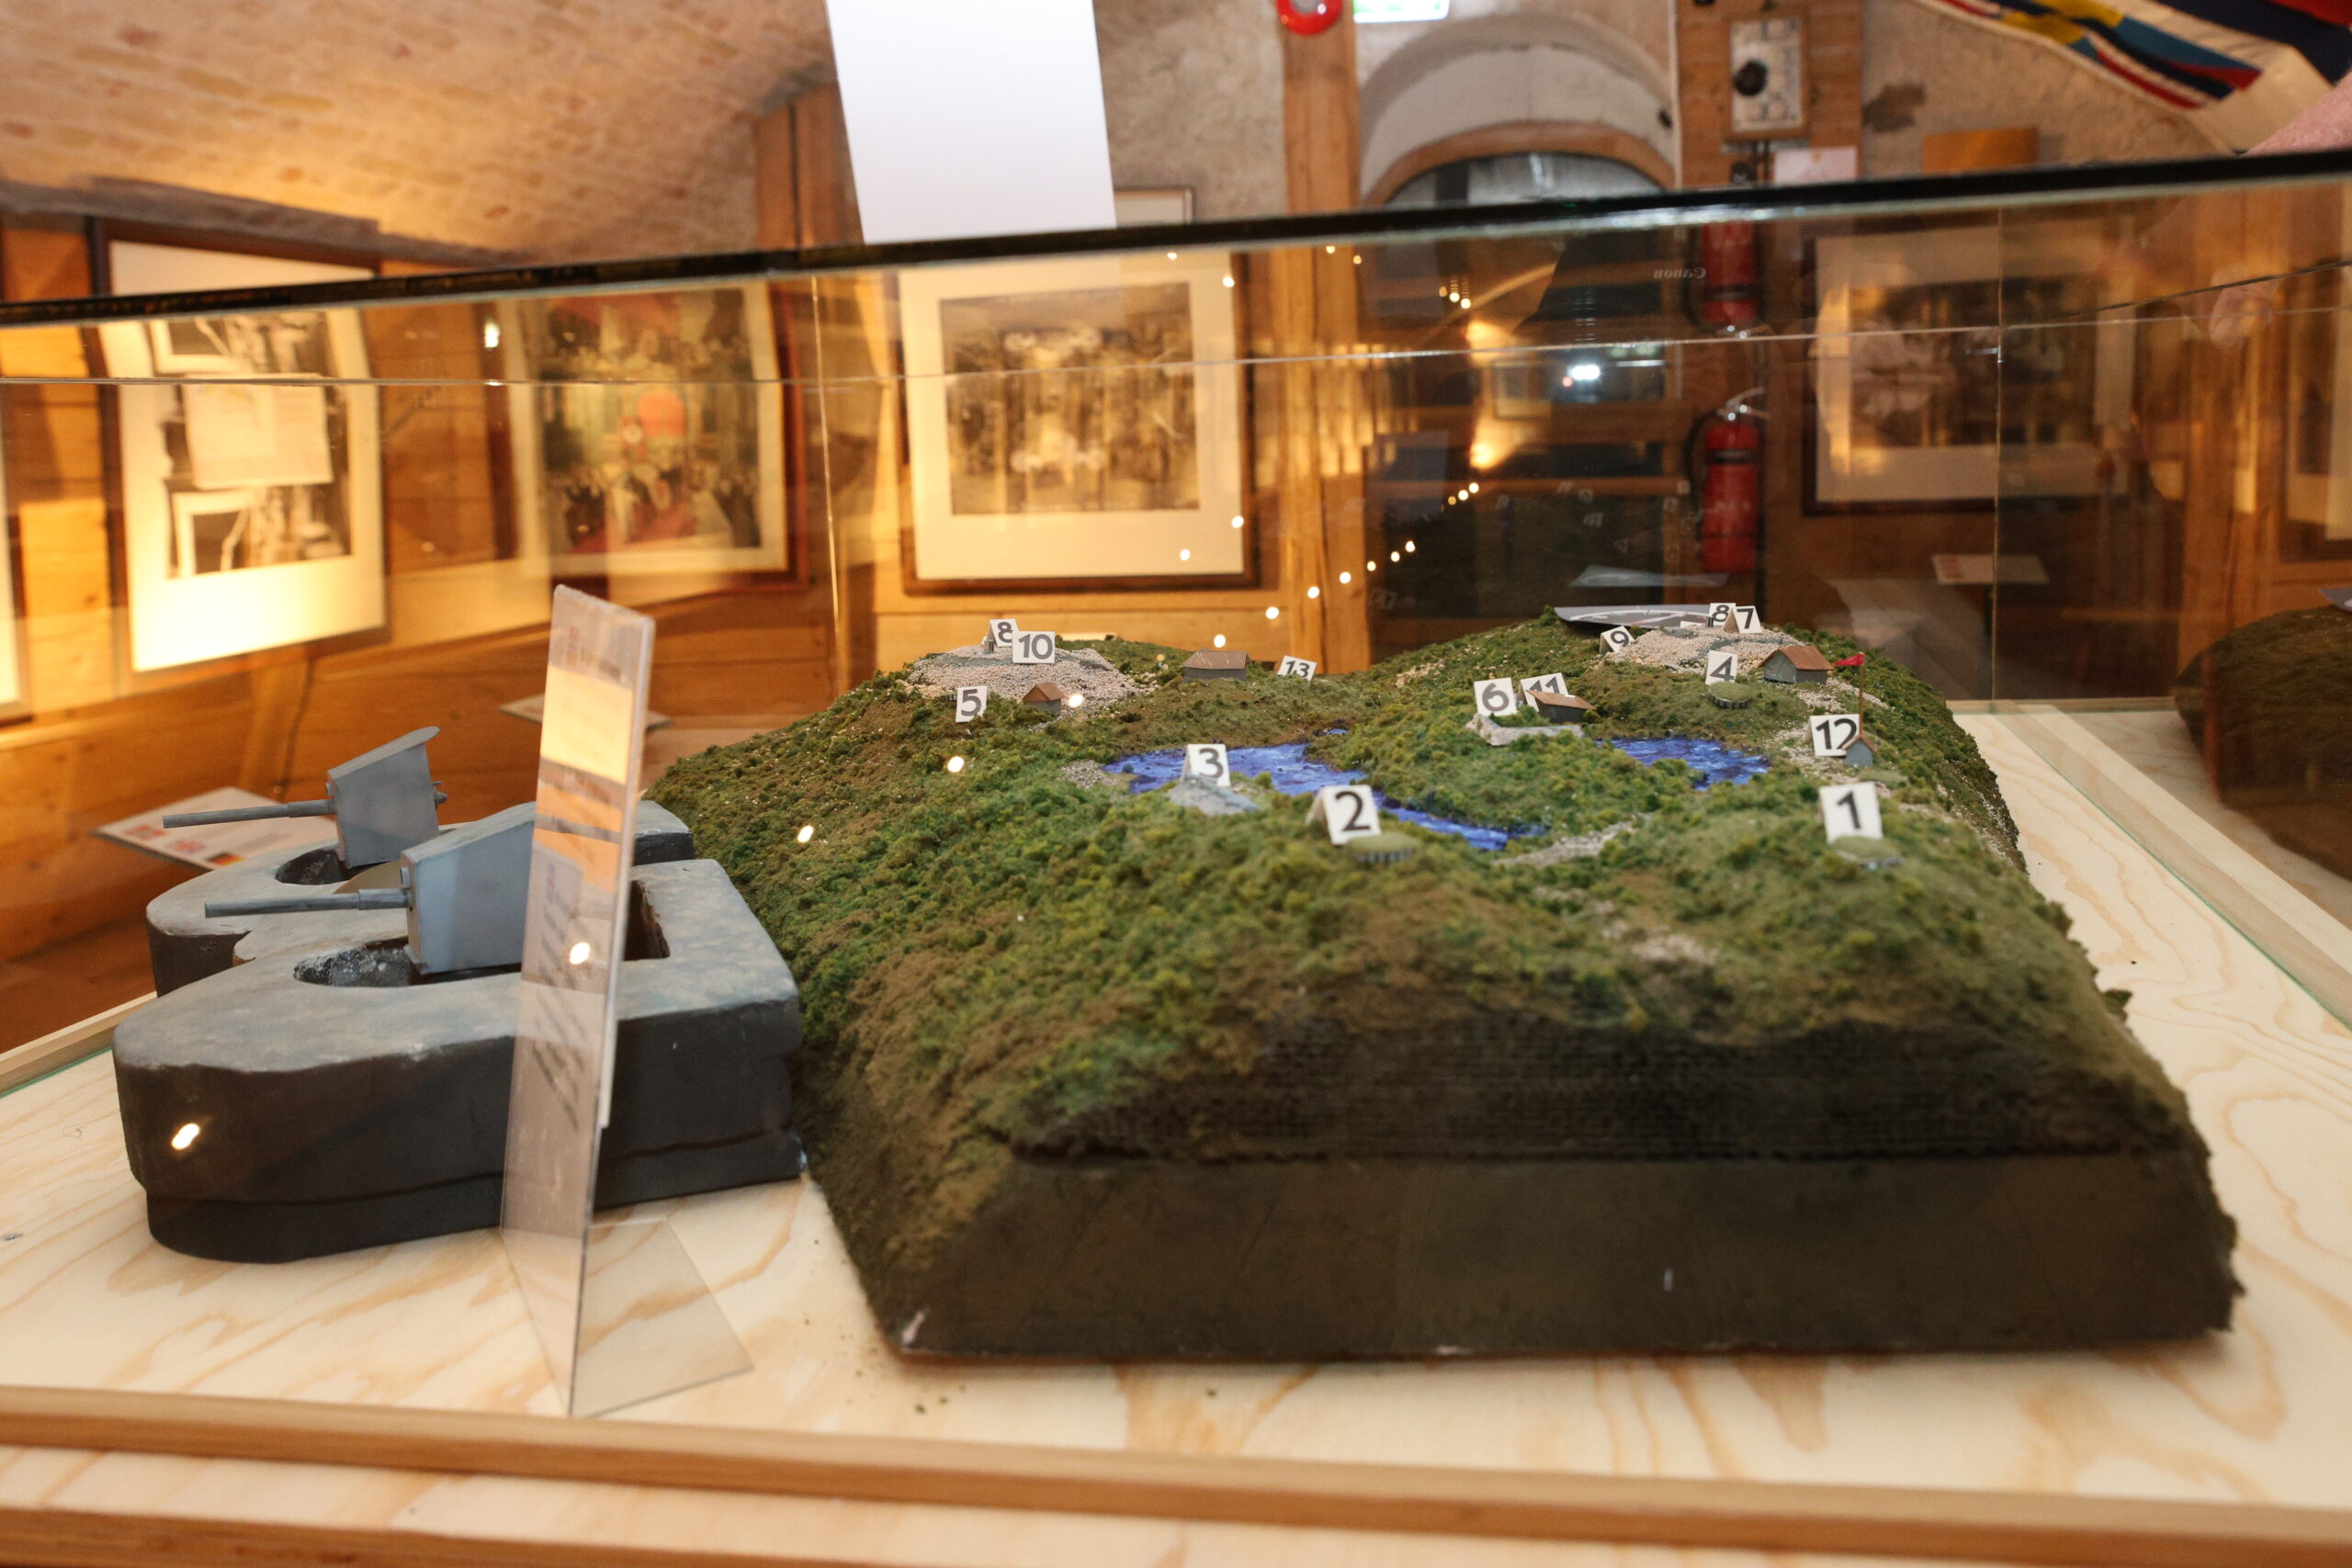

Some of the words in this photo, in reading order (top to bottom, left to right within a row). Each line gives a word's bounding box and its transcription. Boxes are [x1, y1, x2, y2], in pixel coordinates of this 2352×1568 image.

[1712, 604, 1730, 622] 8
[1736, 608, 1754, 629] 7
[998, 621, 1013, 643] 8
[1611, 630, 1630, 648] 9
[1018, 634, 1053, 660] 10
[1286, 660, 1310, 678] 13
[1710, 656, 1735, 682] 4
[961, 689, 981, 716] 5
[1482, 682, 1510, 712] 6
[1815, 718, 1857, 750] 12
[1199, 748, 1224, 779] 3
[1335, 791, 1371, 831] 2
[1837, 790, 1860, 829] 1
